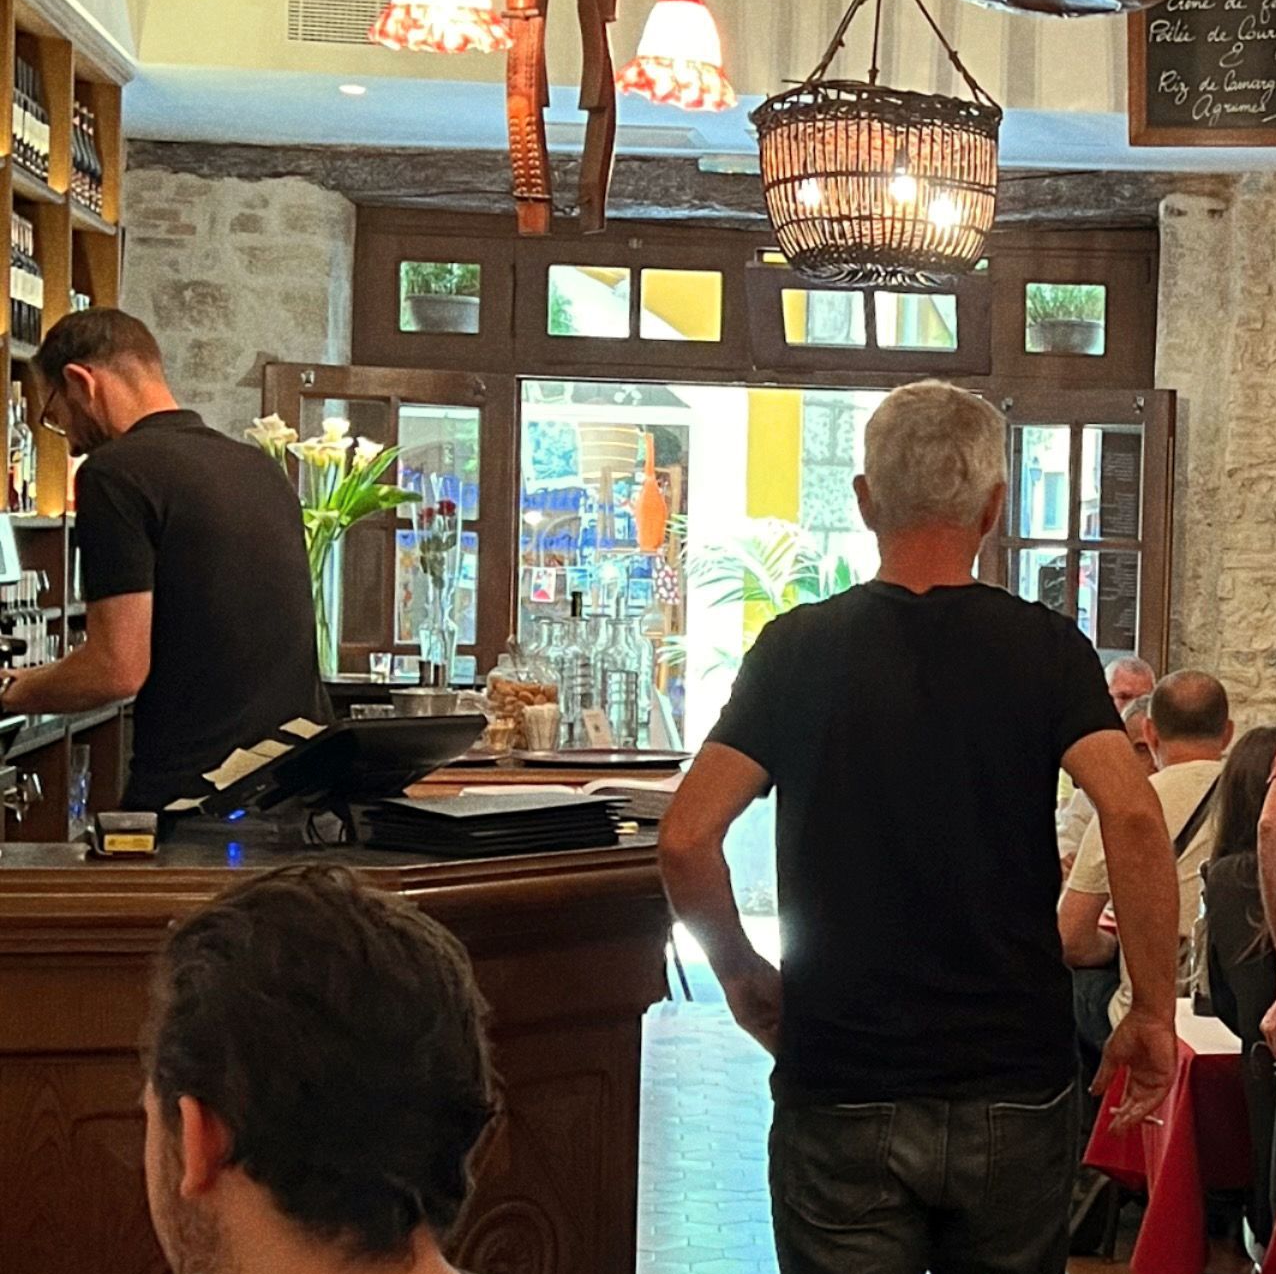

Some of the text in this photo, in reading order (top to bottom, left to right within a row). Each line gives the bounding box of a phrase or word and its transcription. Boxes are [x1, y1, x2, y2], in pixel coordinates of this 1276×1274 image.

[1207, 26, 1233, 42] de
[1158, 69, 1189, 105] Riz
[1199, 76, 1219, 92] de
[1192, 93, 1267, 126] Agrumes
